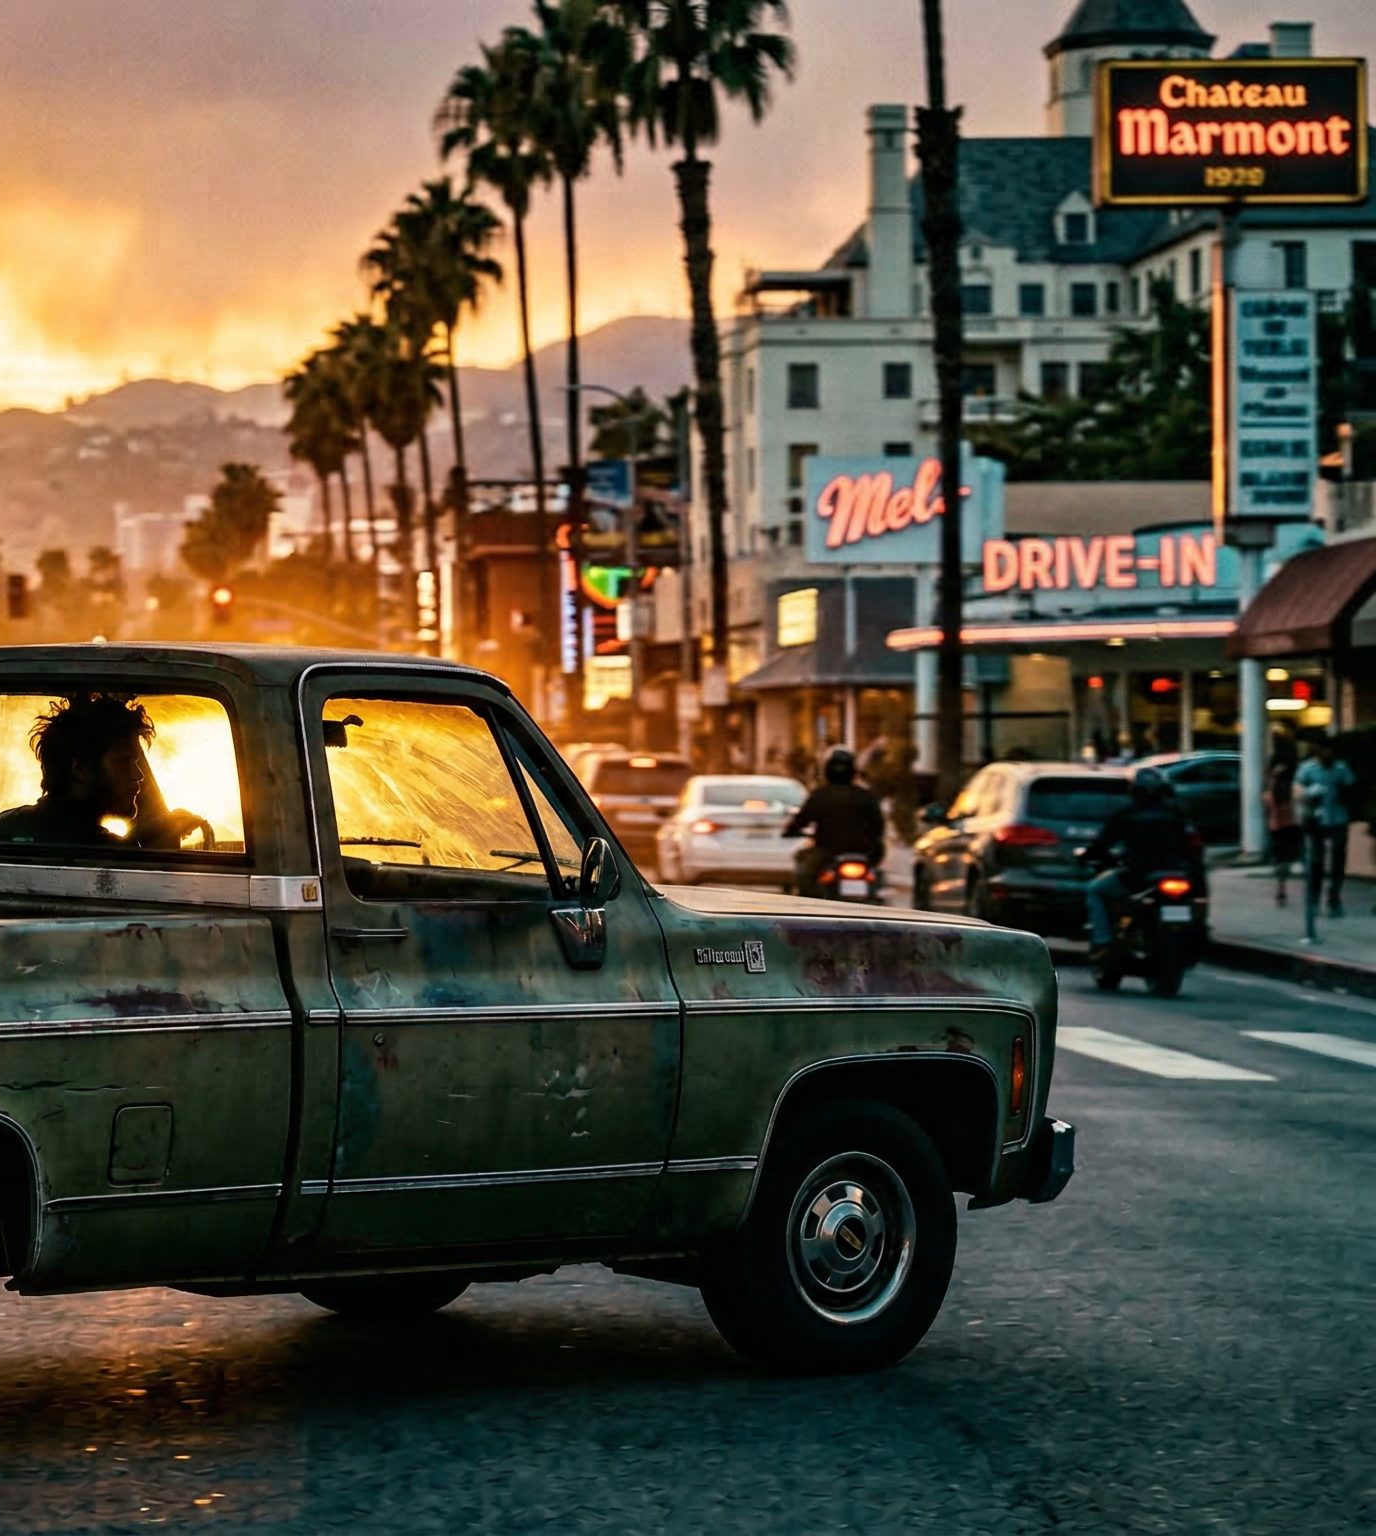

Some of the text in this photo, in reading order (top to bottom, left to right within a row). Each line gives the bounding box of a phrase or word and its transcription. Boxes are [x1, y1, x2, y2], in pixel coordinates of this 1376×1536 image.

[1159, 75, 1307, 108] Chateau
[1118, 109, 1351, 156] Marmont
[983, 532, 1216, 592] DRIVE-IN
